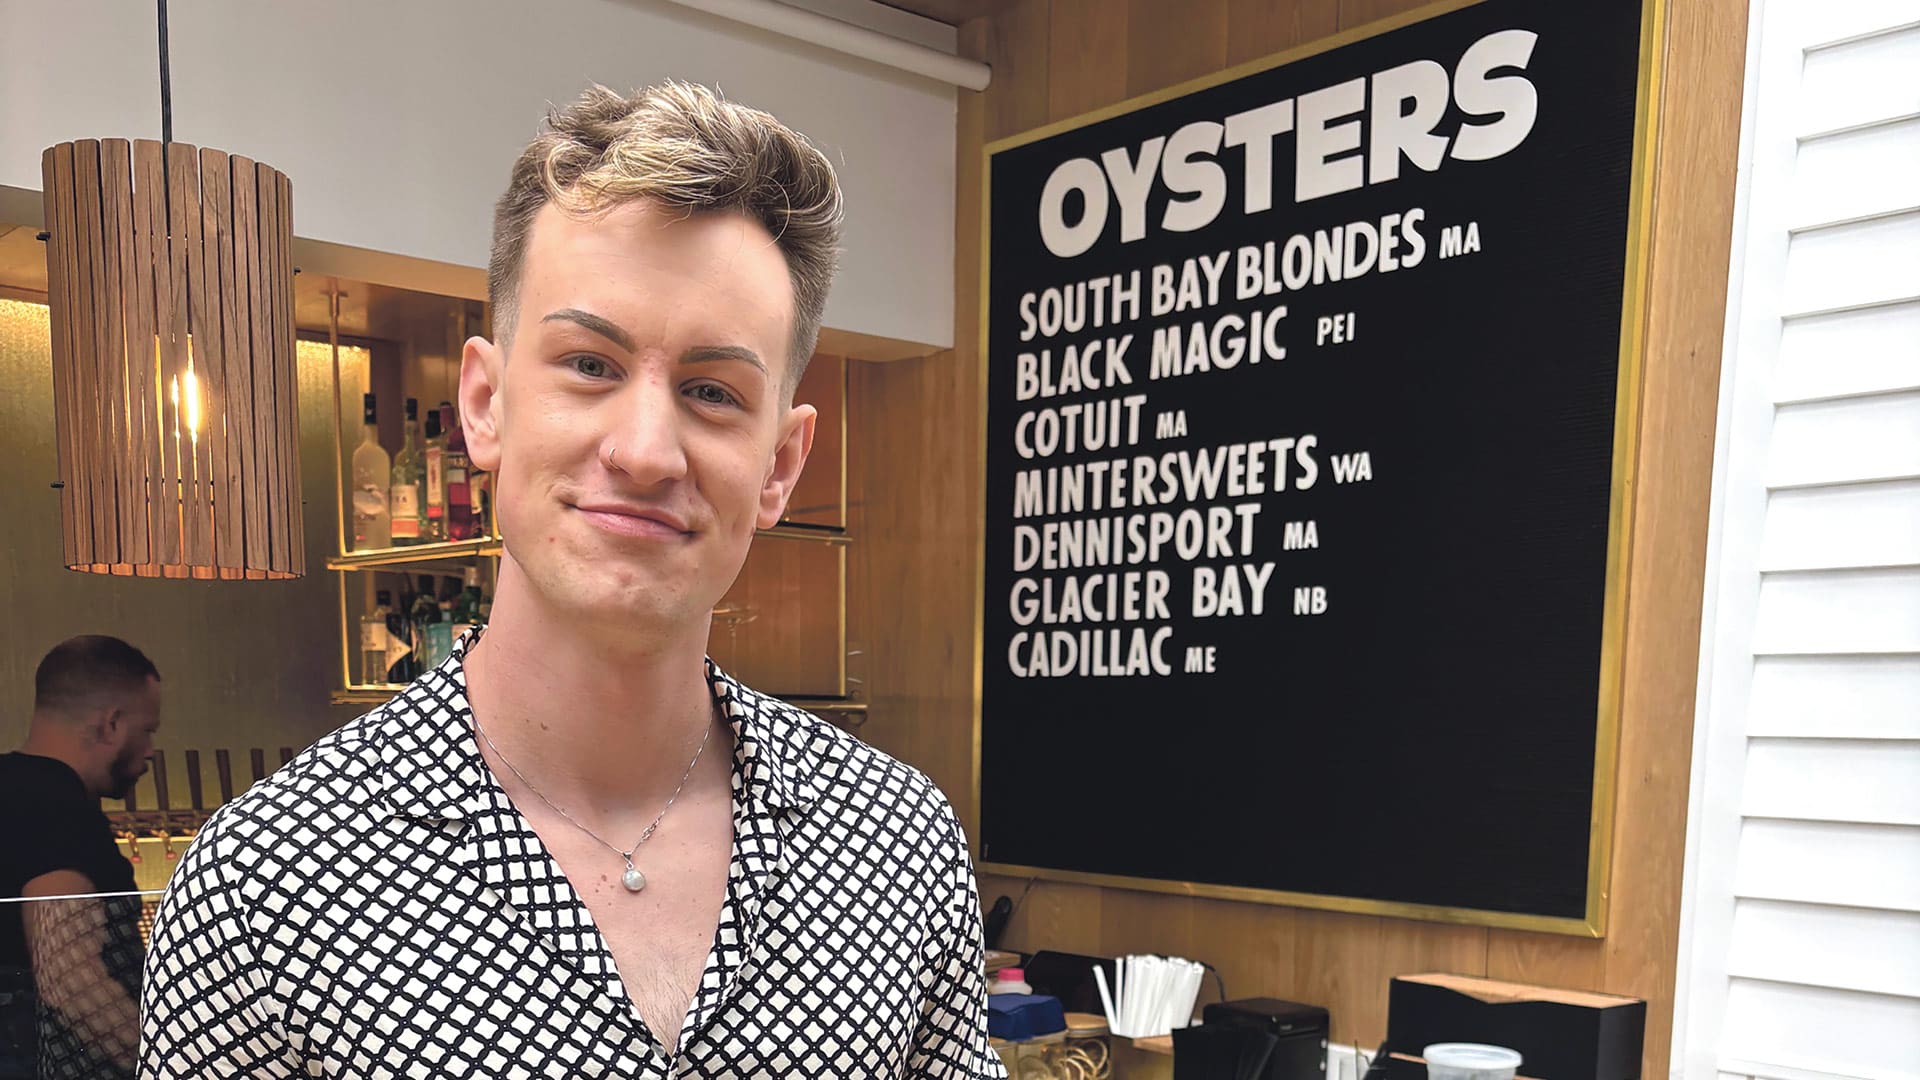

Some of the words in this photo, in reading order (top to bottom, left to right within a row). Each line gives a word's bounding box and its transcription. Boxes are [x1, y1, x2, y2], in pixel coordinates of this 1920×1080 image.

[1039, 29, 1539, 258] OYSTERS
[1020, 270, 1141, 341] SOUTH
[1151, 250, 1231, 317] BAY
[1236, 207, 1426, 300] BLONDES
[1439, 221, 1481, 259] MA
[1016, 334, 1134, 401] BLACK
[1149, 305, 1288, 380] MAGIC
[1316, 312, 1355, 346] PEI
[1015, 394, 1147, 459] COTUIT
[1156, 410, 1188, 440] MA
[1014, 434, 1318, 518] MINTERSWEETS
[1330, 451, 1373, 484] WA
[1014, 502, 1262, 572] DENNISPORT
[1283, 520, 1319, 551] MA
[1010, 570, 1171, 626] GLACIER
[1192, 562, 1276, 618] BAY
[1293, 586, 1328, 616] NB
[1008, 626, 1173, 678] CADILLAC
[1184, 646, 1217, 673] ME
